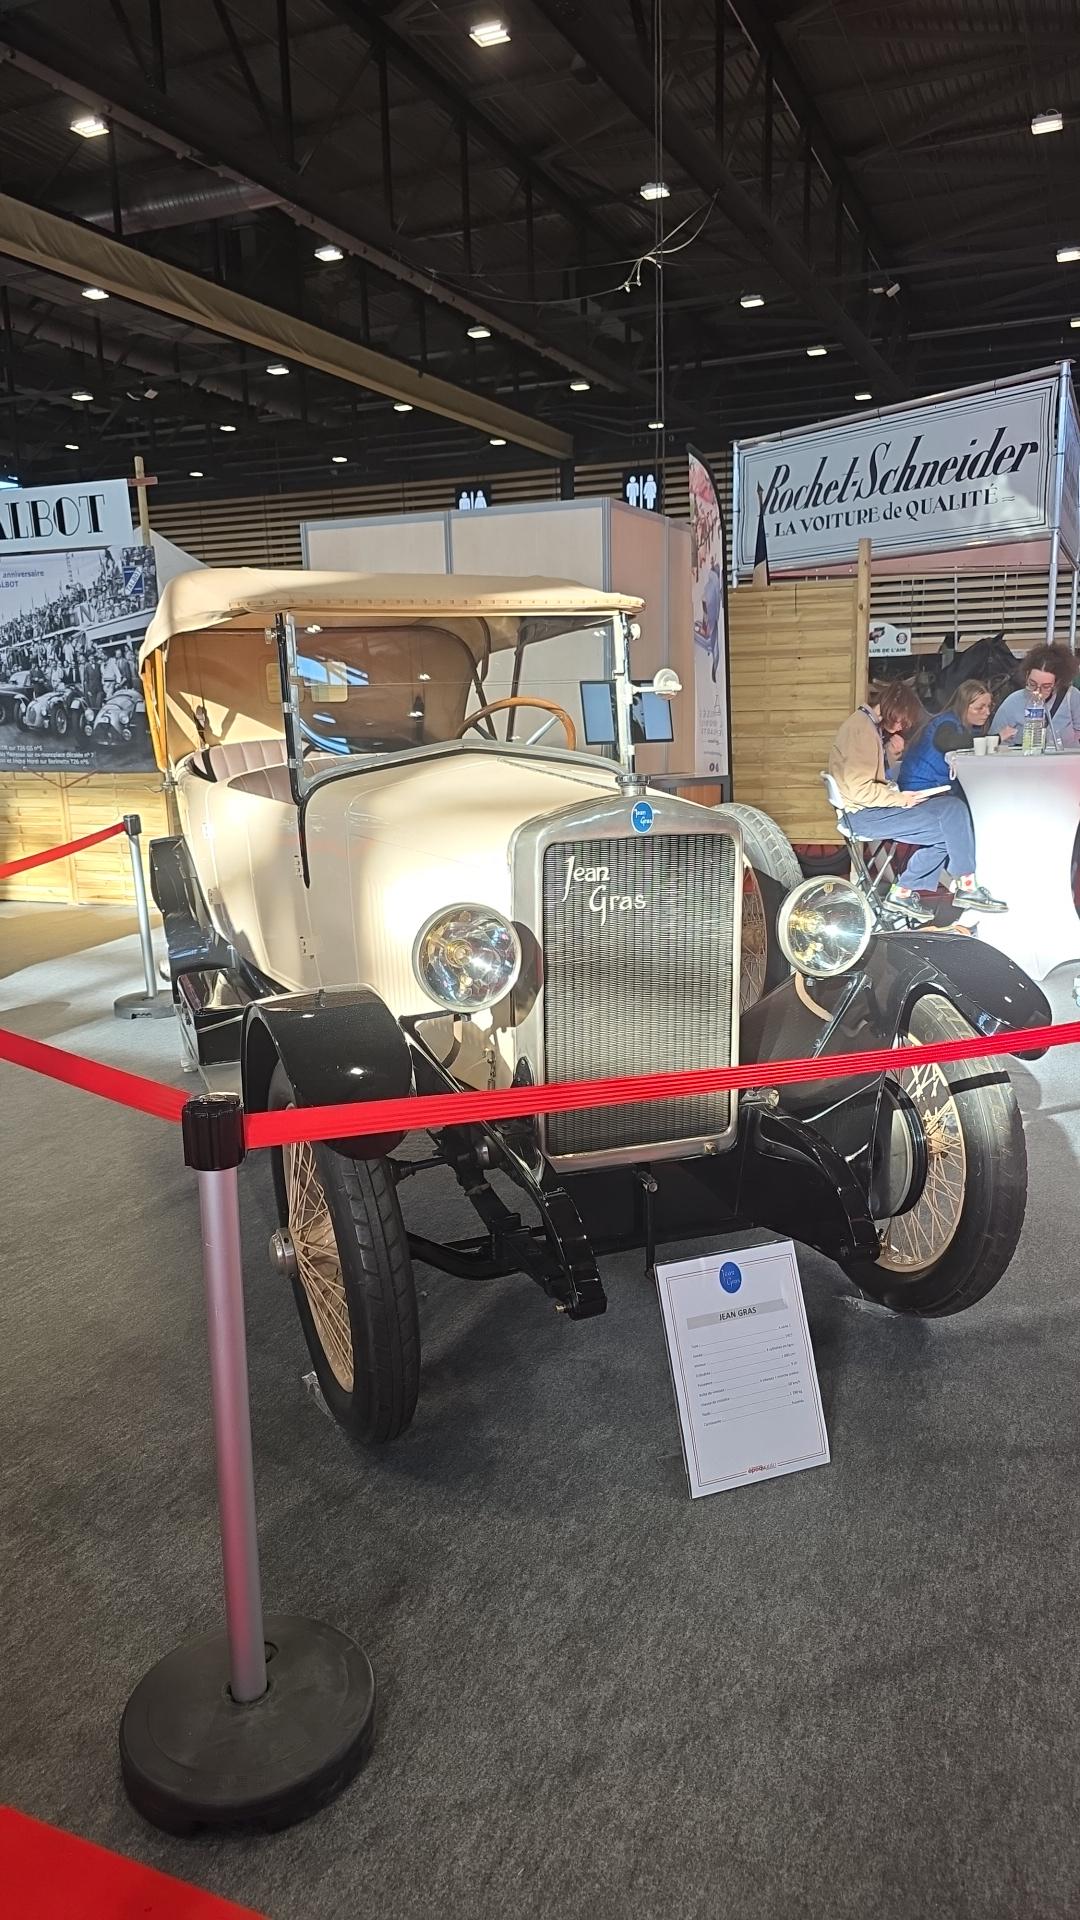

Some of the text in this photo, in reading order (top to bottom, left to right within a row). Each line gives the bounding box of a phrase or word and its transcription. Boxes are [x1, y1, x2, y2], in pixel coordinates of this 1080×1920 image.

[764, 426, 1039, 515] Rochet-Schneider
[775, 483, 998, 537] LA VOITURE de QUALITÉ
[0, 580, 19, 589] LBOT
[2, 569, 45, 579] anniversaire
[126, 567, 141, 592] TALBOT
[562, 856, 610, 902] Jean
[589, 885, 646, 927] Gras
[719, 1306, 757, 1321] JEAN GRAS
